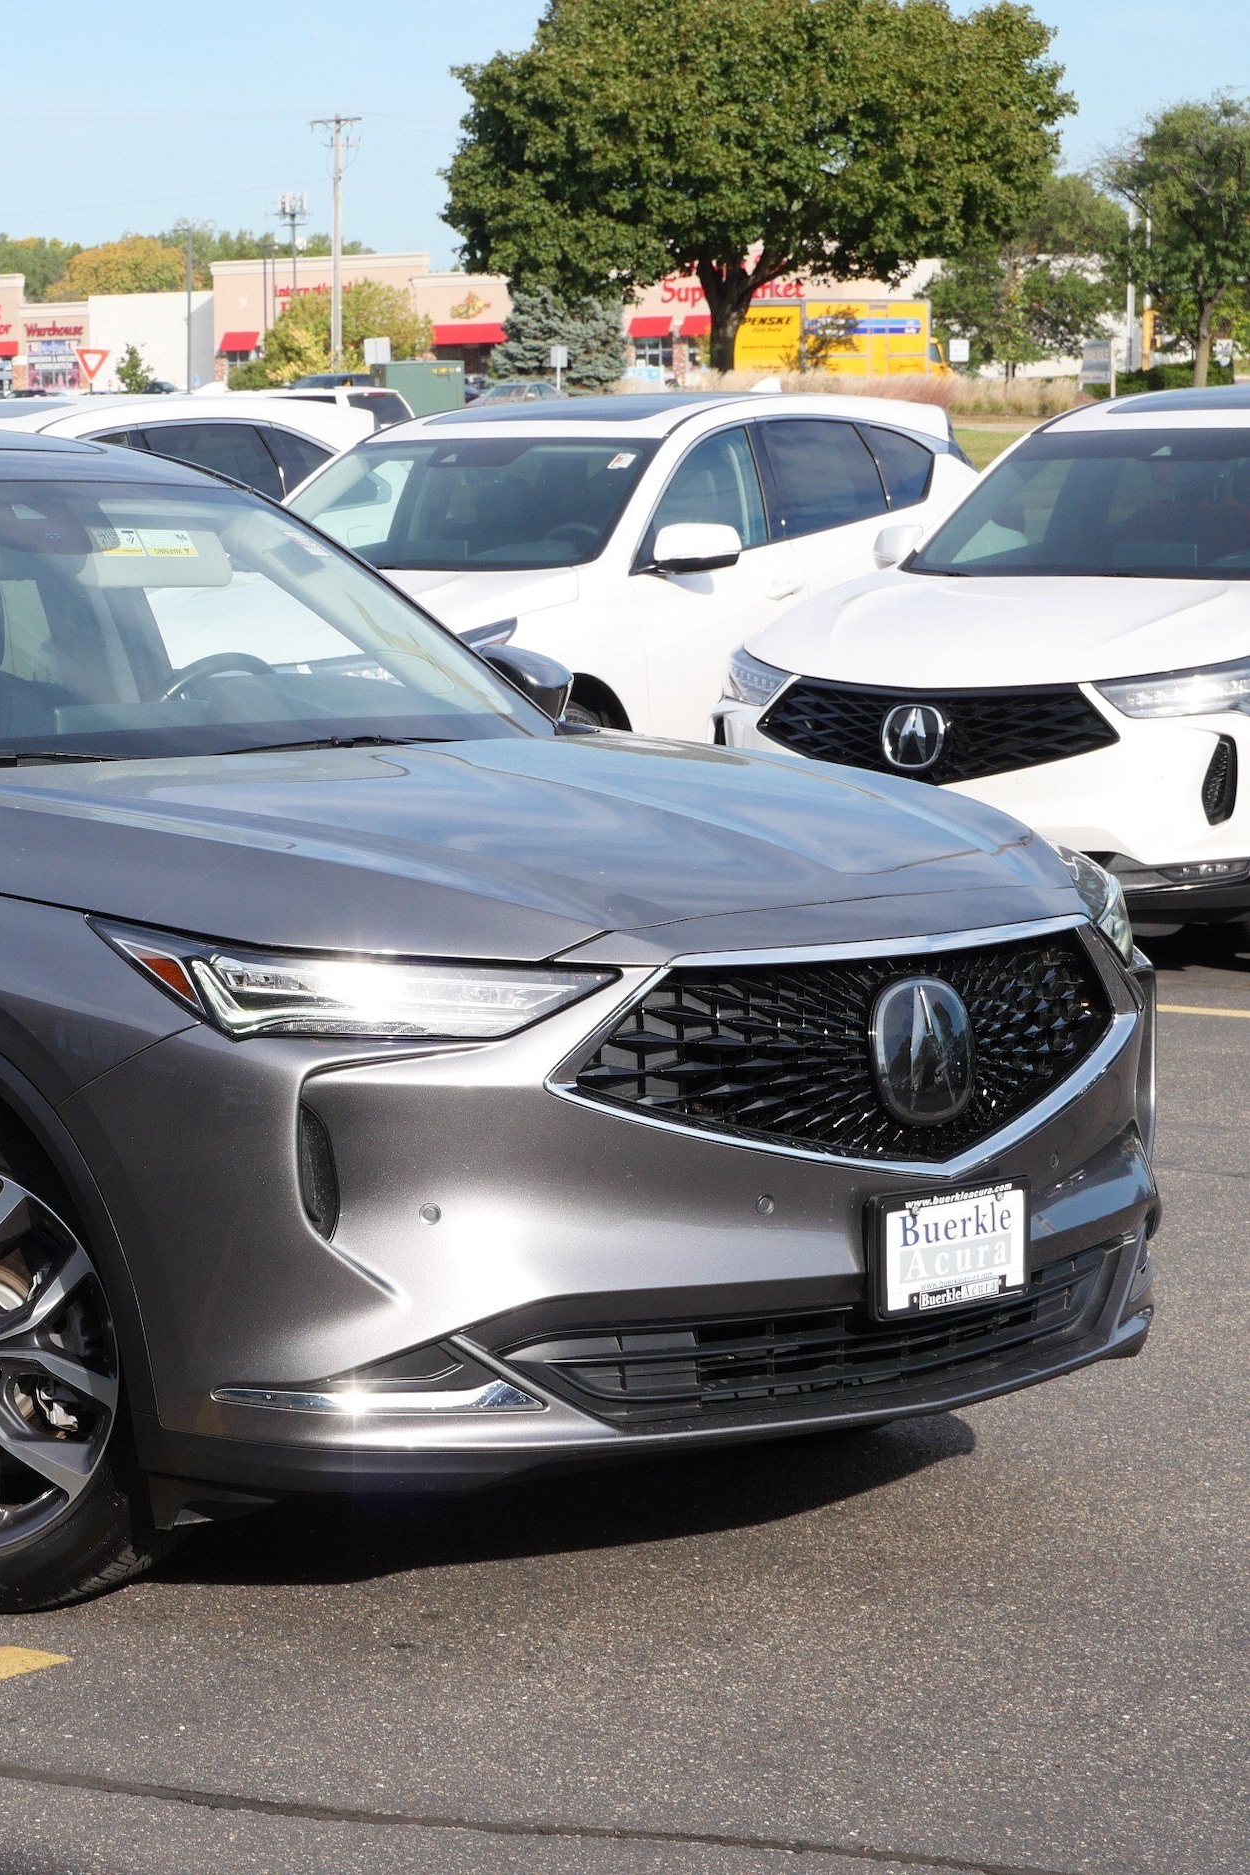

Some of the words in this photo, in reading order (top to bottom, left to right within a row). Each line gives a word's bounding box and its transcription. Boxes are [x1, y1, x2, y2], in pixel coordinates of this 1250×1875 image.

[25, 320, 84, 337] Warehouse
[743, 316, 793, 326] PENSKE
[905, 1183, 1012, 1209] www.buerkleacura.com
[899, 1202, 1012, 1247] Buerkle
[904, 1241, 1007, 1281] Acura
[921, 1287, 961, 1307] Buerkle
[963, 1281, 996, 1297] Acura
